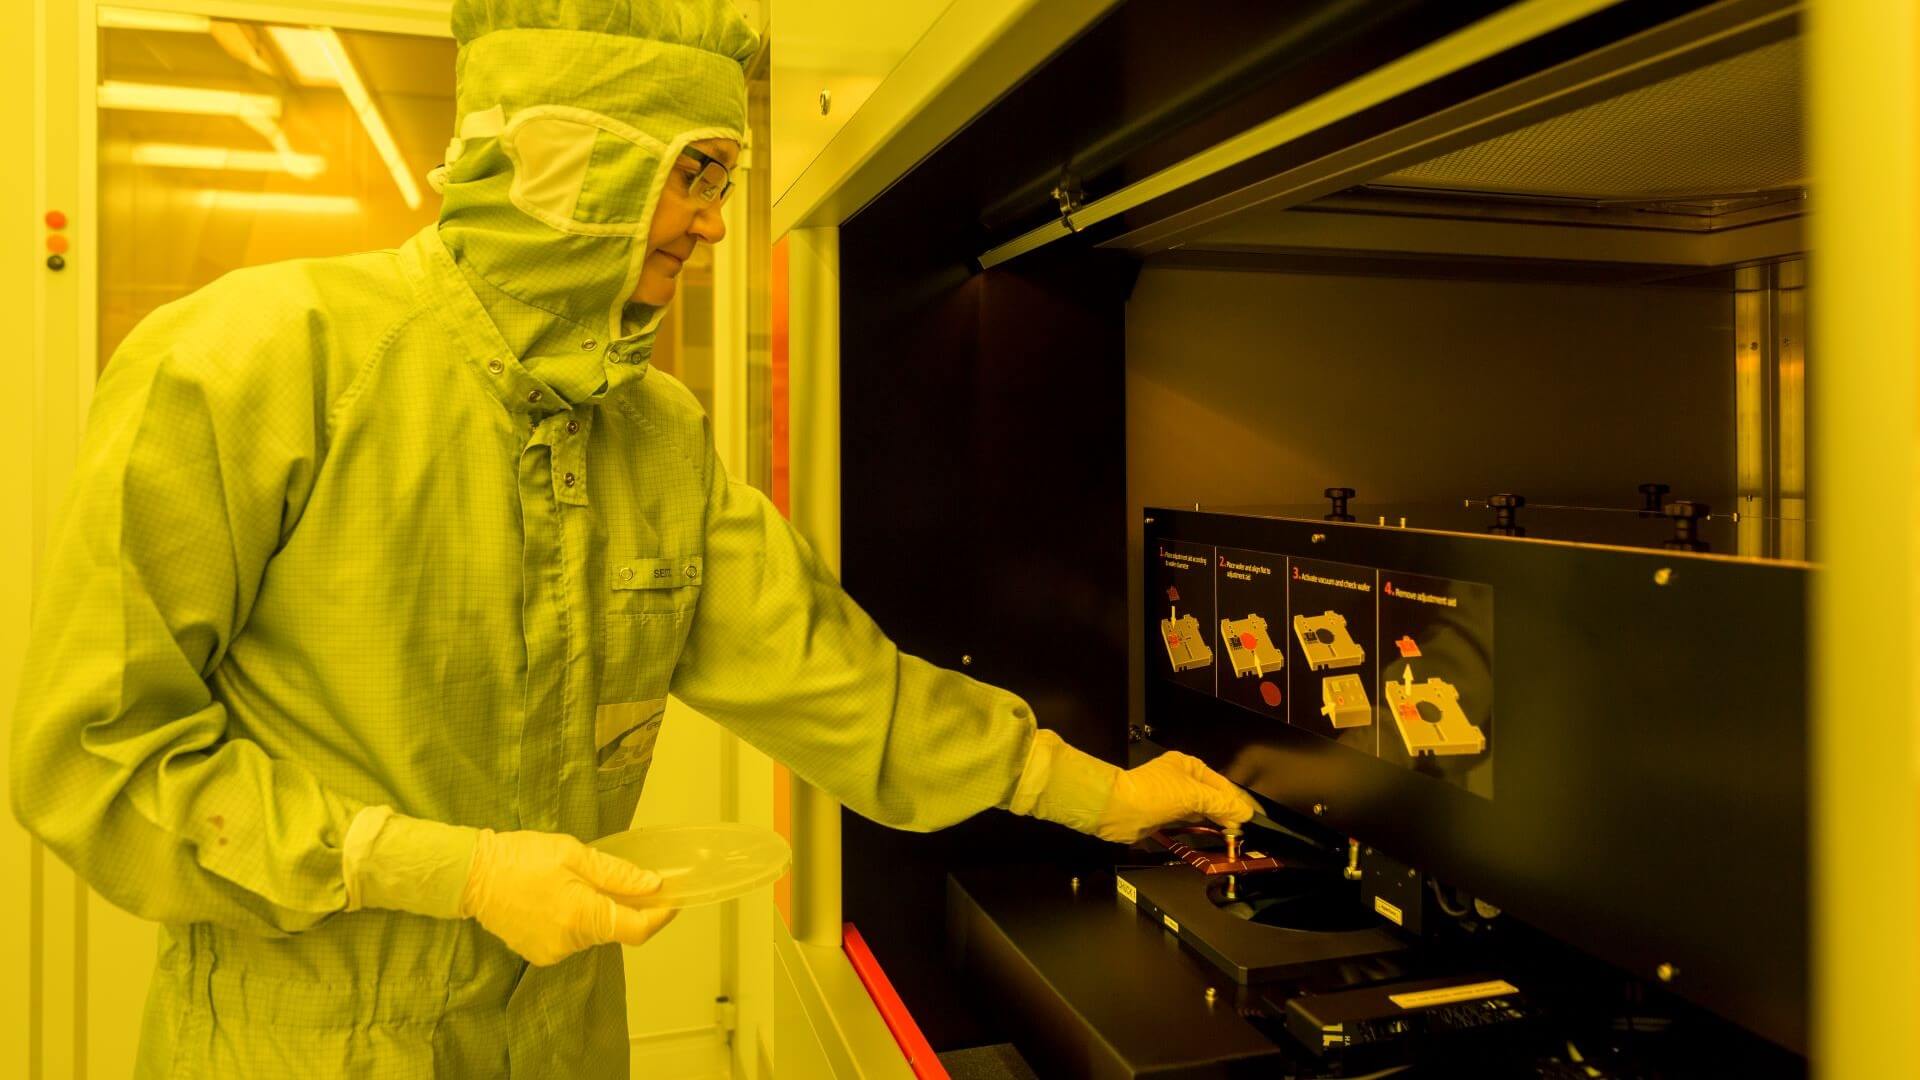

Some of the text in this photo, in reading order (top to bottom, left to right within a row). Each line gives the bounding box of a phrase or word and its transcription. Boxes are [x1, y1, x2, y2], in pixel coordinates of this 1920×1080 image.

[1292, 566, 1371, 592] 3. Activate vacuum and check wafer
[1384, 581, 1394, 596] 4.
[1395, 588, 1416, 601] Remove
[1416, 593, 1447, 606] adjustment
